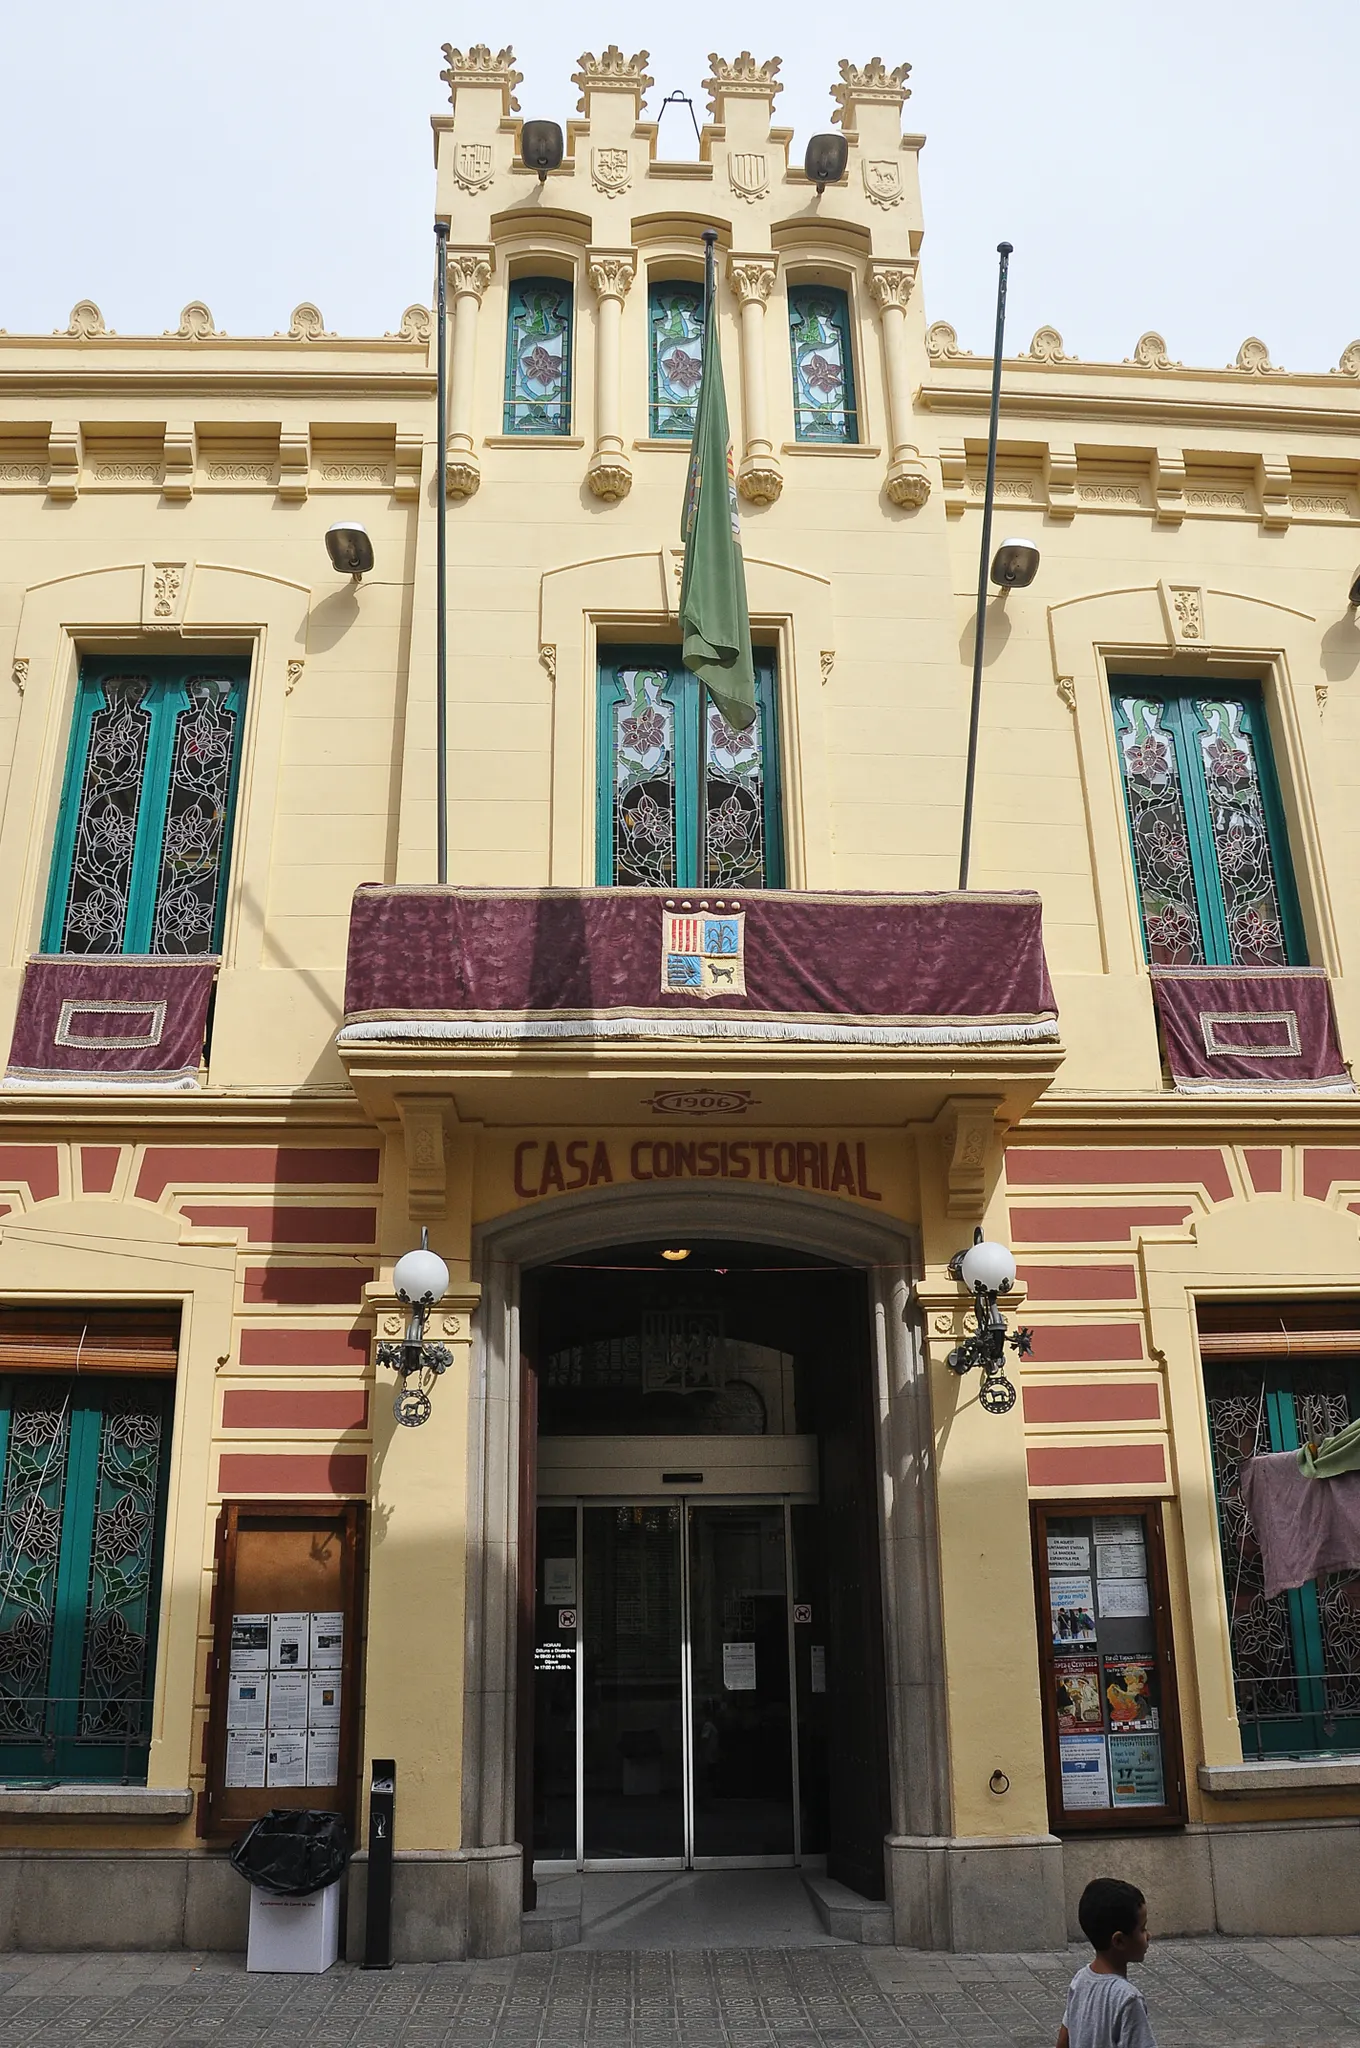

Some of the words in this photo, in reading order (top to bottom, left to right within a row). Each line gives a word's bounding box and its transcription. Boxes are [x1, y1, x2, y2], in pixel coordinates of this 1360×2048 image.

[673, 1096, 732, 1108] 1906
[514, 1141, 613, 1198] CASA
[630, 1141, 882, 1201] CONSISTORIAL
[1117, 1768, 1133, 1779] 17
